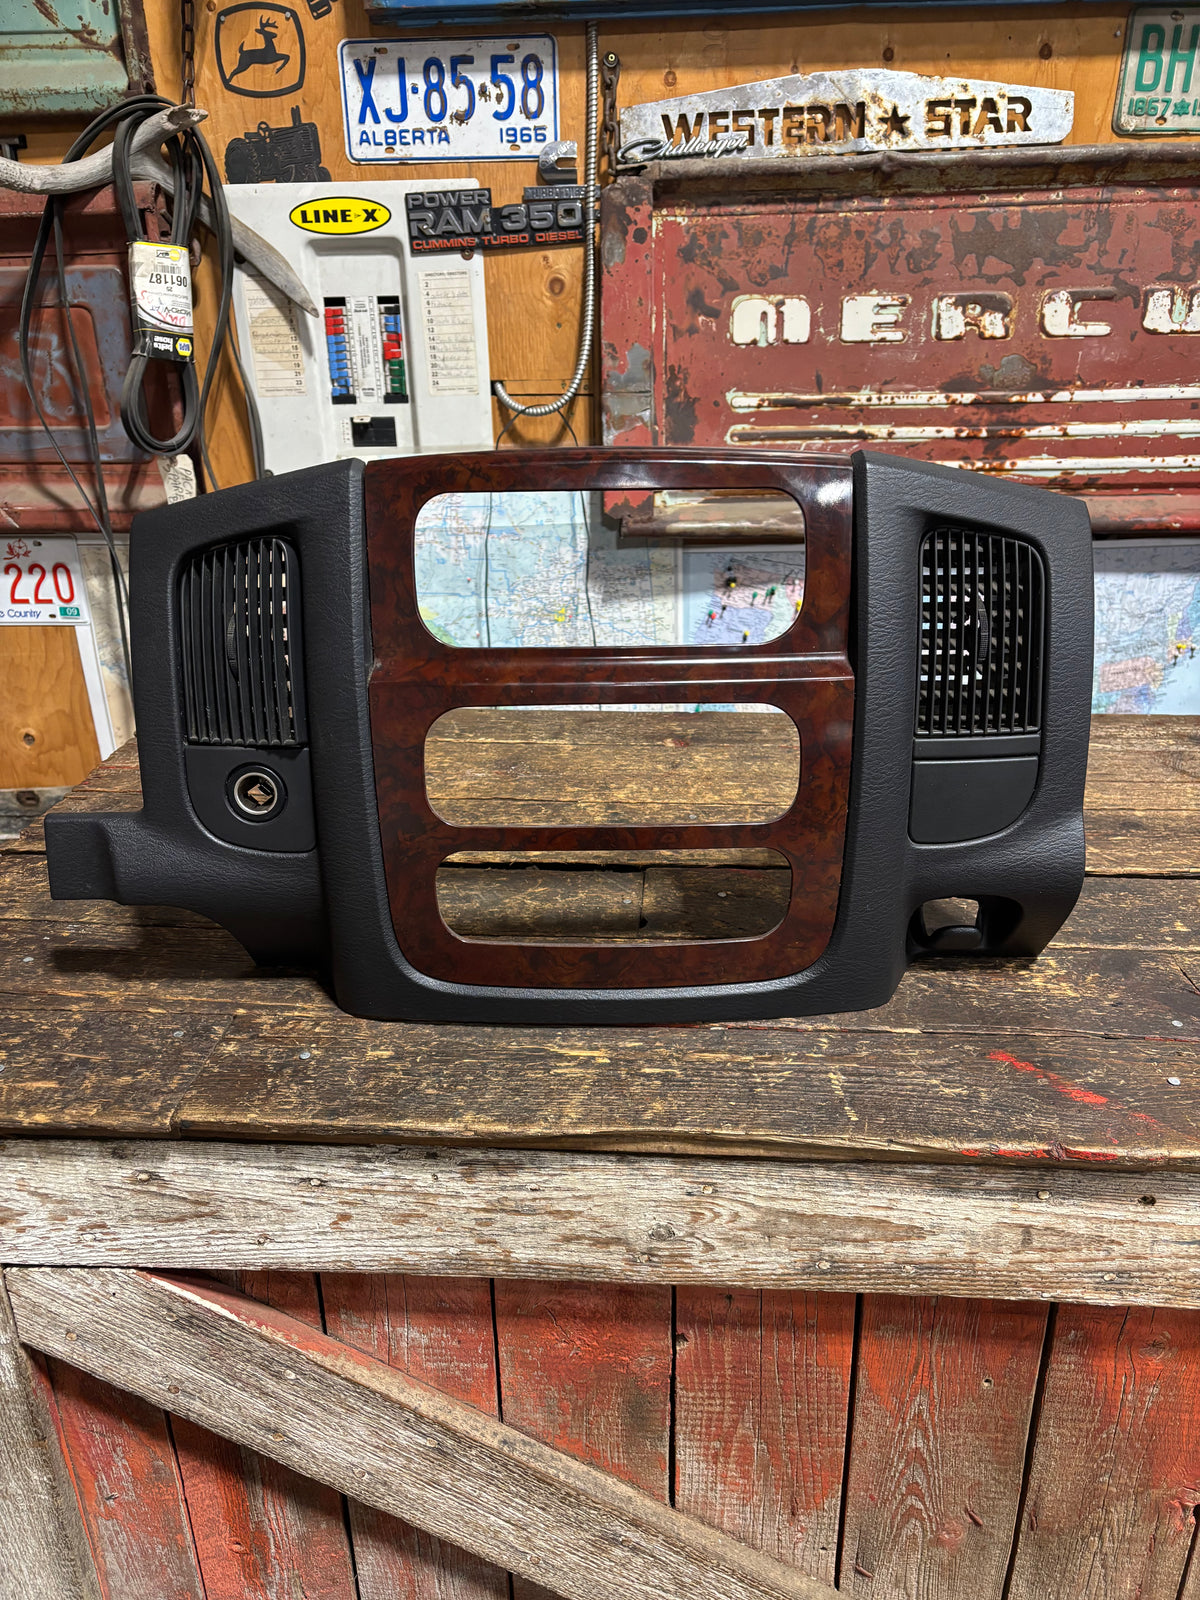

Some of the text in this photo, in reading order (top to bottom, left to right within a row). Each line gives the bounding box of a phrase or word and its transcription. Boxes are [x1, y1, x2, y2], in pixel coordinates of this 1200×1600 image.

[1127, 97, 1172, 117] 1867
[661, 95, 1033, 147] WESTERN STAR
[359, 126, 547, 146] ALBERTA 1966
[617, 136, 747, 164] Challenger
[407, 189, 490, 209] POWER
[409, 203, 582, 237] RAM 350
[412, 230, 583, 251] CUMMINS TURBO DIESEL
[148, 274, 188, 288] 061187
[7, 608, 42, 619] Country
